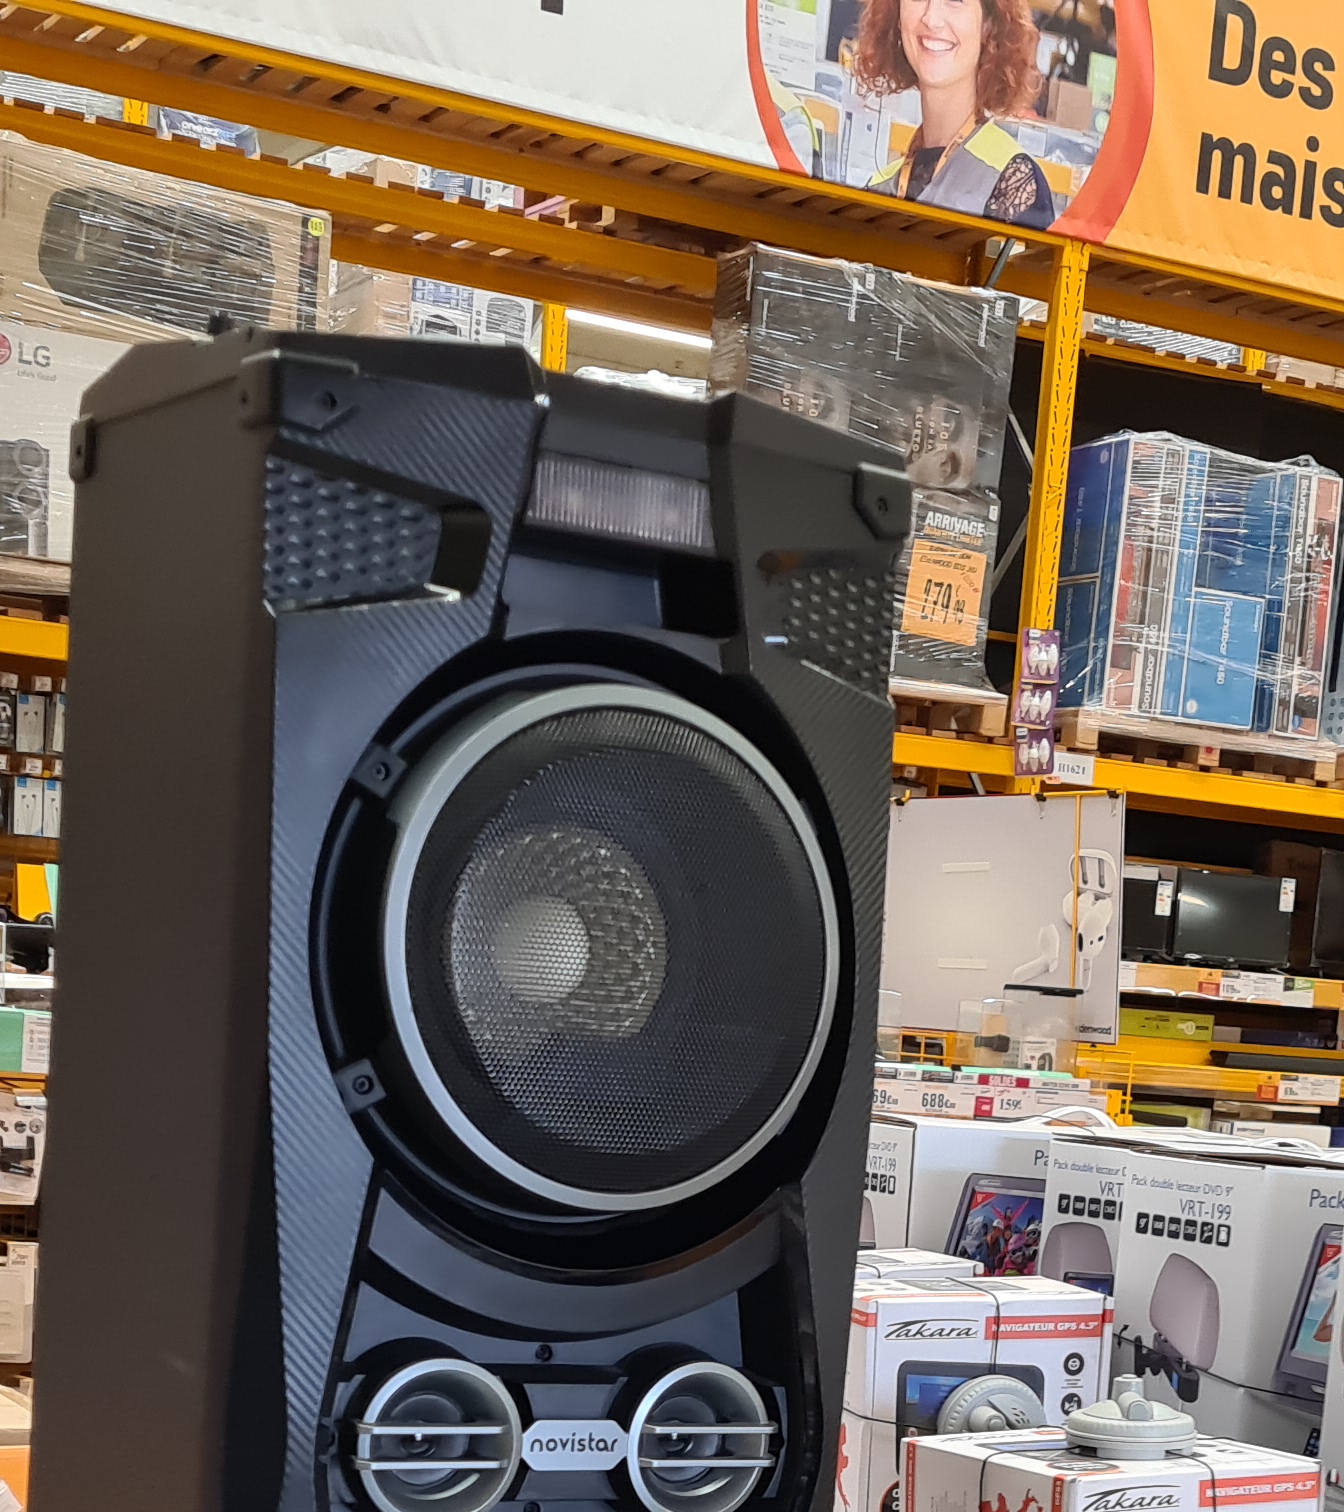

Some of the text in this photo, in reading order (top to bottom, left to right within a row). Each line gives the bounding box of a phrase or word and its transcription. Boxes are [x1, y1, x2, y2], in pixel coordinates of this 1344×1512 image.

[1207, 0, 1334, 111] Des
[17, 341, 52, 369] LG
[925, 511, 985, 538] ARRIVAGE
[1179, 1199, 1232, 1221] VRT-199
[884, 1318, 979, 1341] Takara
[530, 1430, 618, 1454] novistar
[1274, 1482, 1295, 1495] GPS
